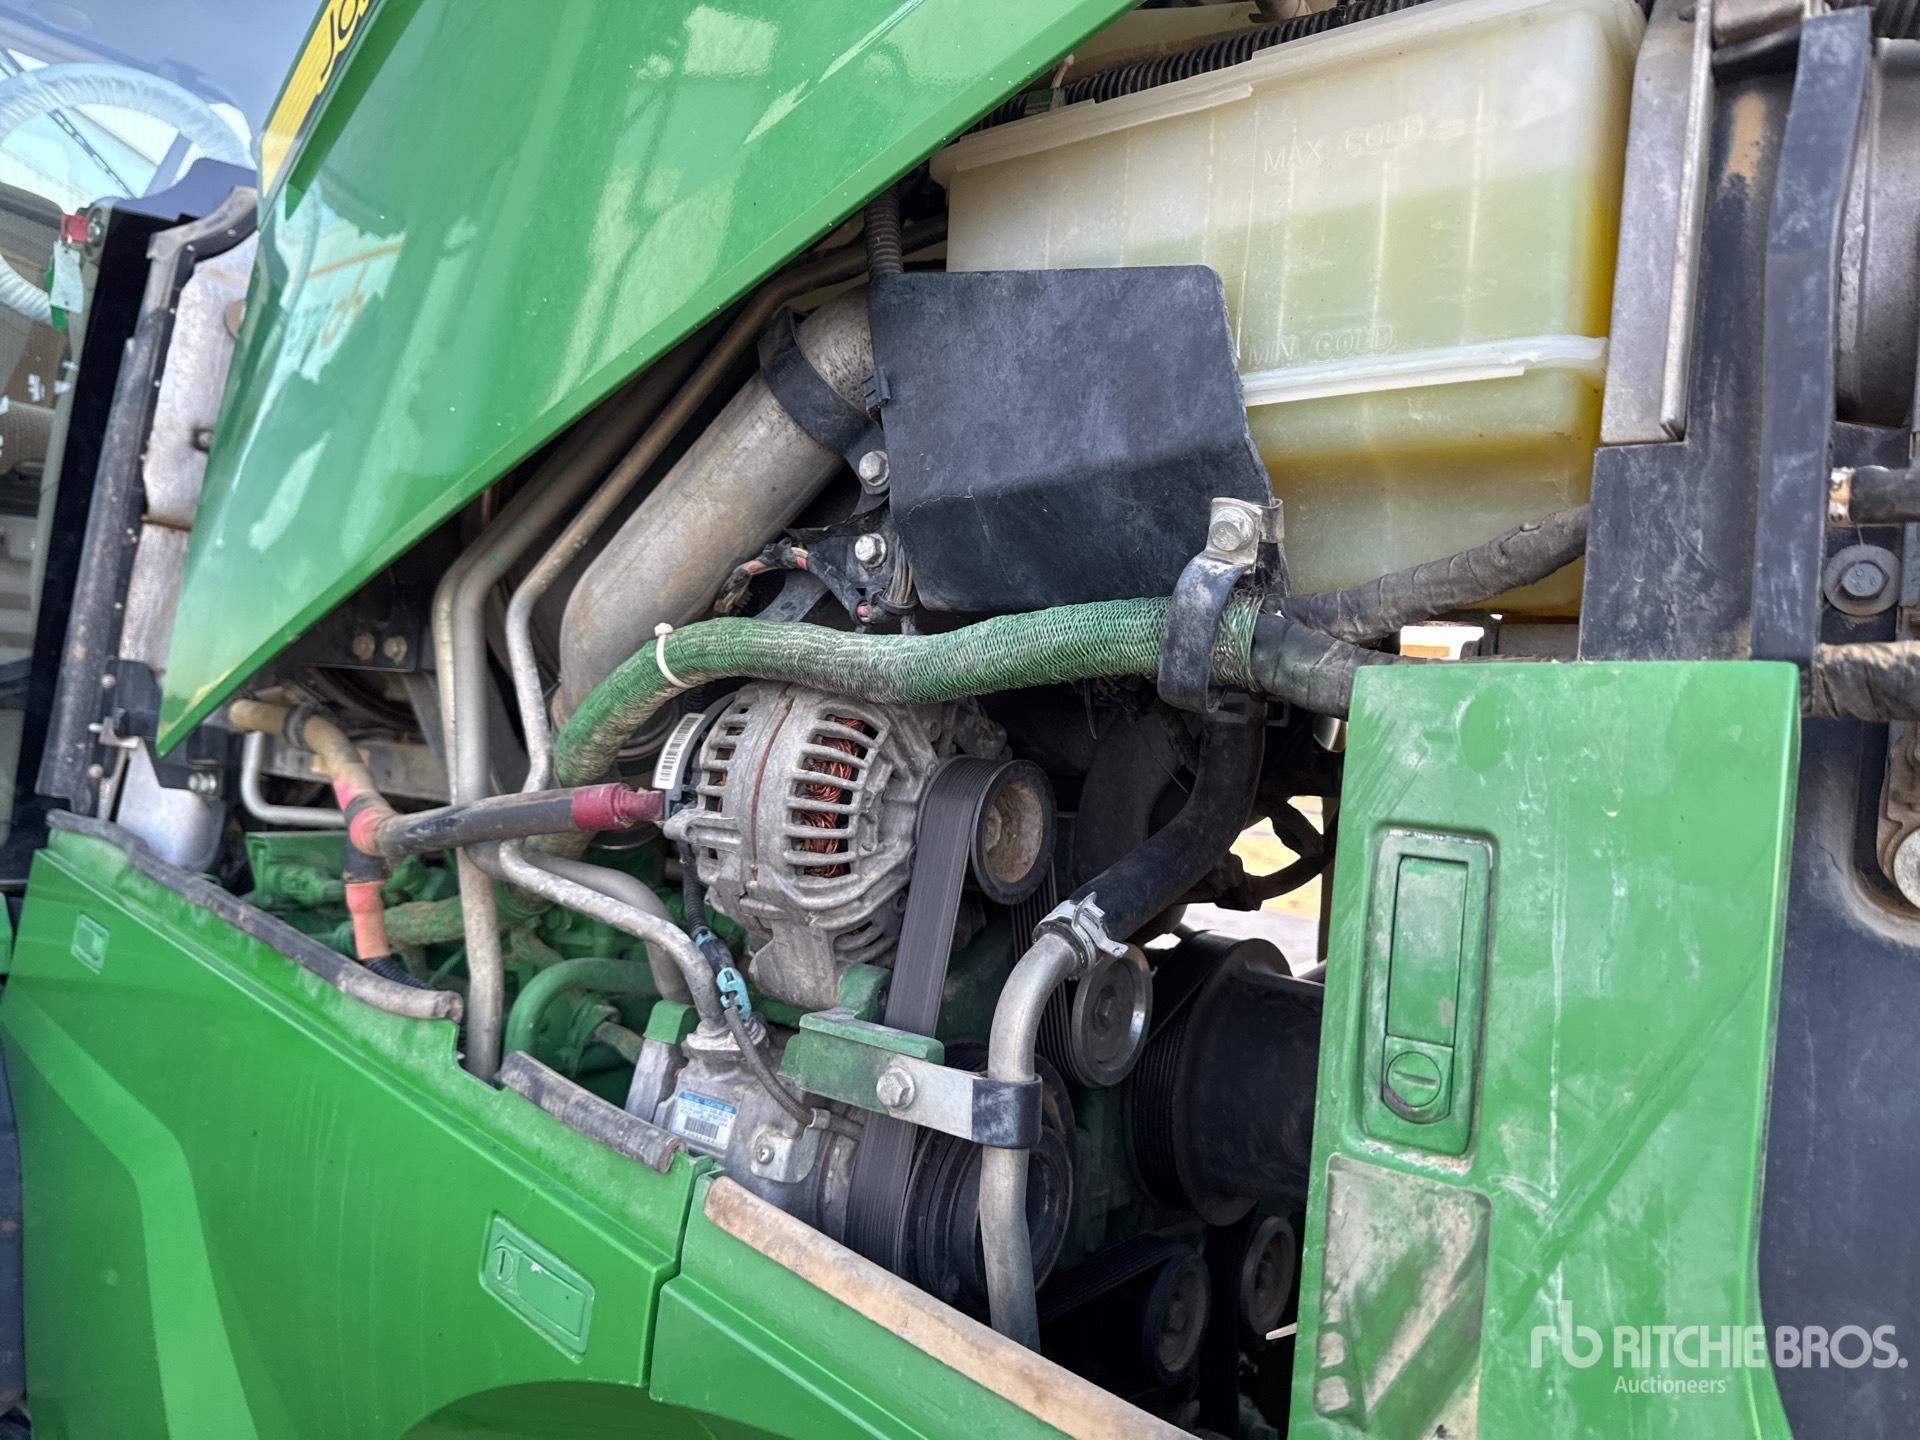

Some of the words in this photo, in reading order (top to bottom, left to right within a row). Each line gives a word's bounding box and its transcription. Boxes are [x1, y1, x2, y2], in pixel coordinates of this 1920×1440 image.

[1264, 138, 1323, 173] MAX
[1345, 115, 1425, 158] COLD
[1250, 334, 1297, 367] MIN
[1313, 324, 1394, 358] COLD
